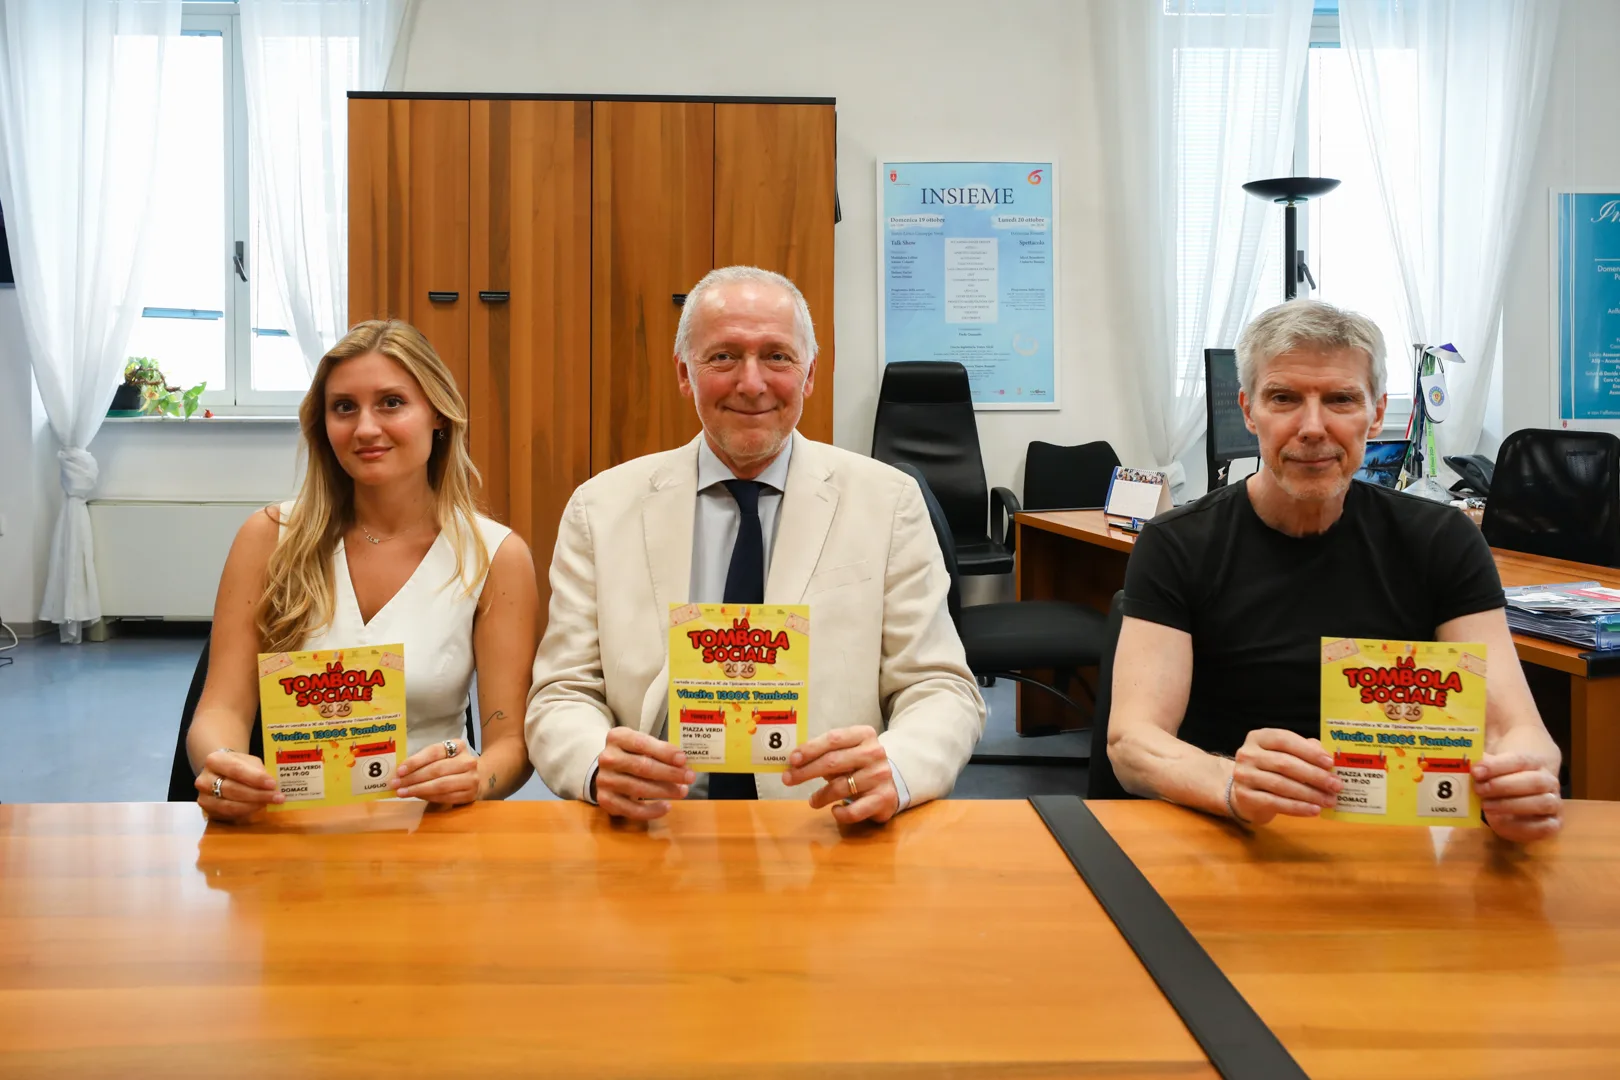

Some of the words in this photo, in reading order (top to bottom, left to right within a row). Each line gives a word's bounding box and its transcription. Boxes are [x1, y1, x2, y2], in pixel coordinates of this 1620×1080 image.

[921, 188, 1014, 204] INSIEME
[733, 618, 750, 630] LA
[687, 629, 789, 650] TOMBOLA
[703, 647, 777, 664] SOCIALE
[1396, 656, 1416, 669] LA
[326, 662, 344, 673] LA
[726, 664, 754, 673] 2026
[279, 669, 385, 695] TOMBOLA
[1343, 667, 1463, 693] TOMBOLA
[296, 687, 373, 707] SOCIALE
[677, 689, 714, 699] Vincita
[716, 691, 750, 700] 1300€
[752, 690, 798, 700] Tombola
[1360, 686, 1448, 707] SOCIALE
[321, 703, 350, 714] 2026
[1388, 705, 1420, 716] 2026
[271, 731, 310, 742] Vincita
[312, 728, 347, 739] 1300€
[350, 722, 396, 736] Tombola
[769, 732, 782, 749] 8
[1330, 730, 1373, 743] Vincita
[1376, 733, 1416, 745] 1300€
[1418, 736, 1472, 747] Tombola
[369, 762, 382, 777] 8
[1437, 781, 1452, 799] 8
